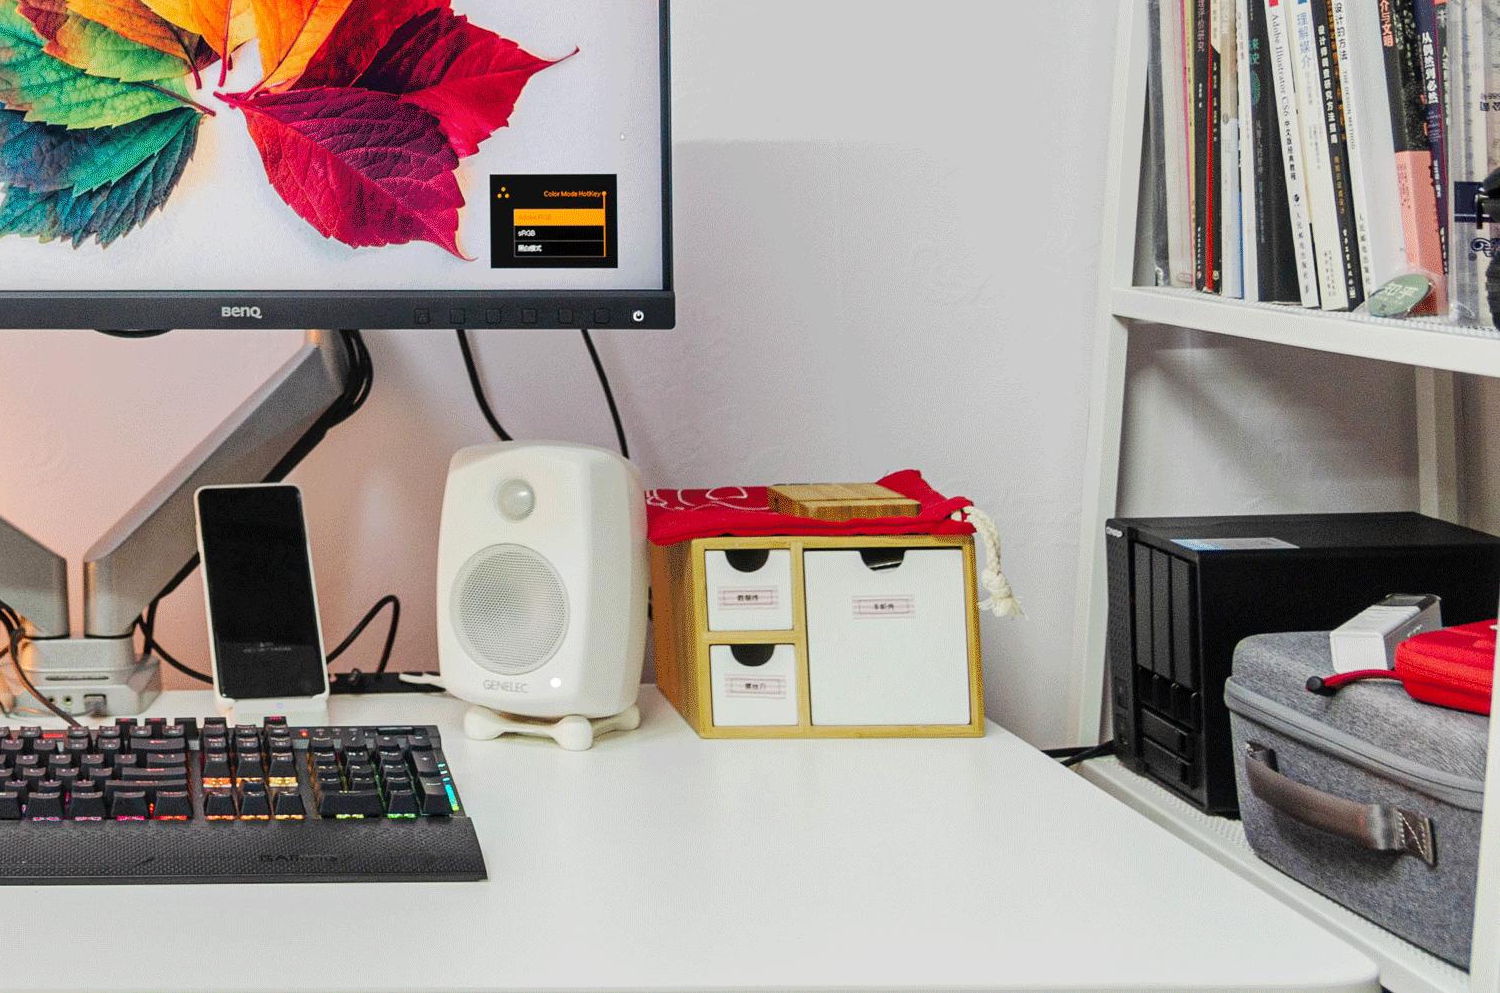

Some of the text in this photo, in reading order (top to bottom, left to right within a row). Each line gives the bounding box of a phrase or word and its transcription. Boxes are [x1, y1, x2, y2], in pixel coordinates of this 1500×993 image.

[1296, 12, 1312, 69] 理解媒介
[1334, 2, 1349, 61] 设计的方法
[1270, 13, 1297, 181] Adobe Illustrator CS6 中文版经典教程
[1421, 32, 1439, 105] 从偶然到必然
[221, 305, 263, 320] BenQ
[1385, 283, 1420, 300] 知乎
[482, 679, 529, 694] GENELEC
